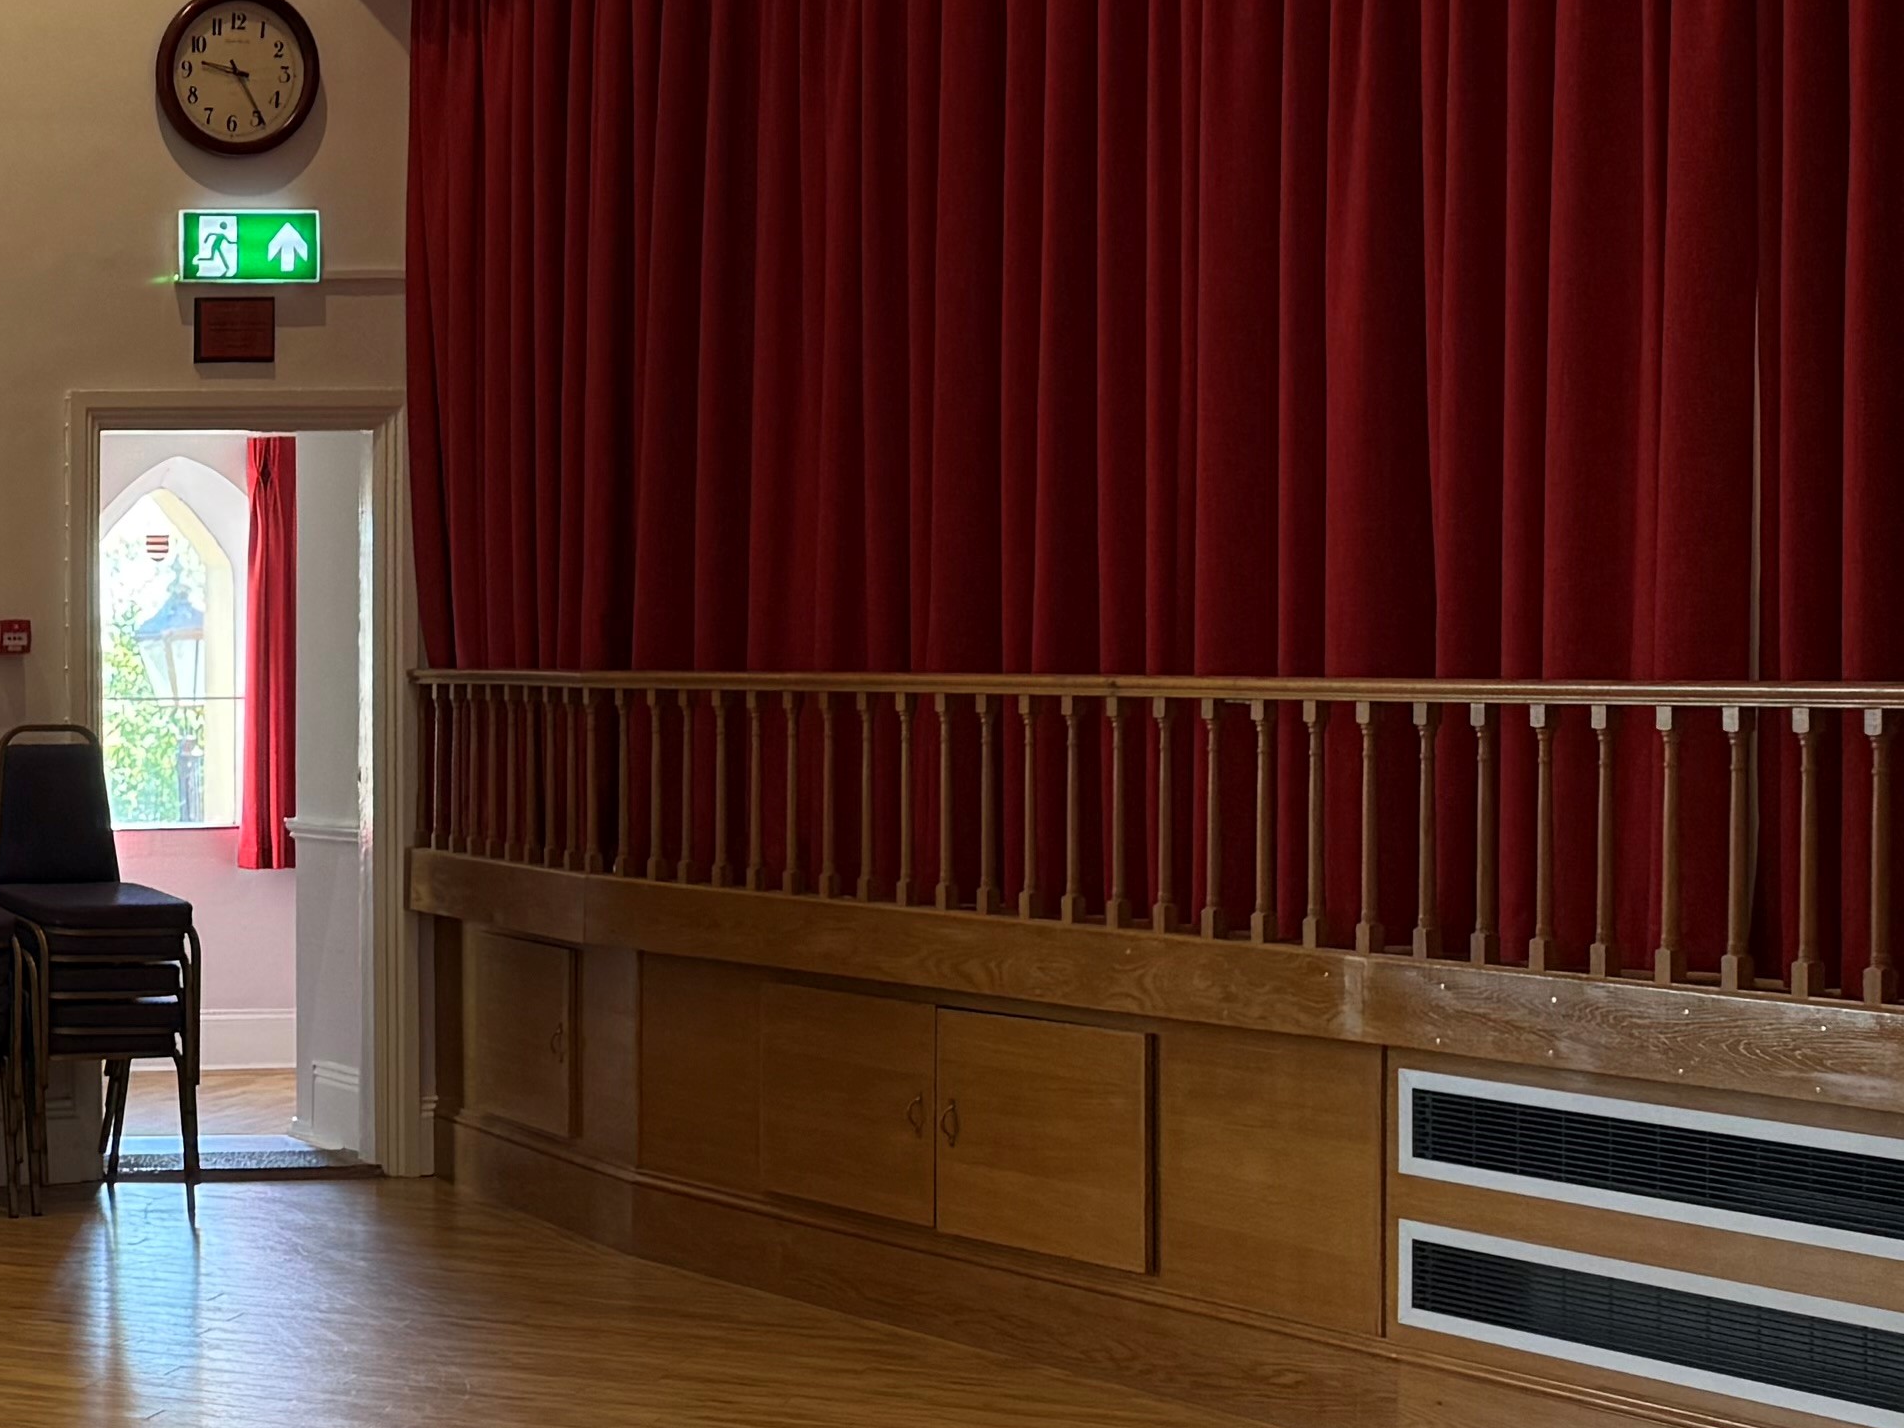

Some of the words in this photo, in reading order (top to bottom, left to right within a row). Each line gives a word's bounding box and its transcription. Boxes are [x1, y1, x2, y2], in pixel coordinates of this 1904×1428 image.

[212, 17, 223, 36] 11
[231, 12, 247, 30] 12
[260, 21, 266, 39] 1
[192, 35, 207, 53] 10
[273, 40, 284, 58] 2
[181, 60, 193, 79] 9
[278, 65, 291, 84] 3
[187, 85, 198, 104] 8
[268, 90, 281, 109] 4
[204, 107, 214, 125] 7
[226, 114, 238, 132] 6
